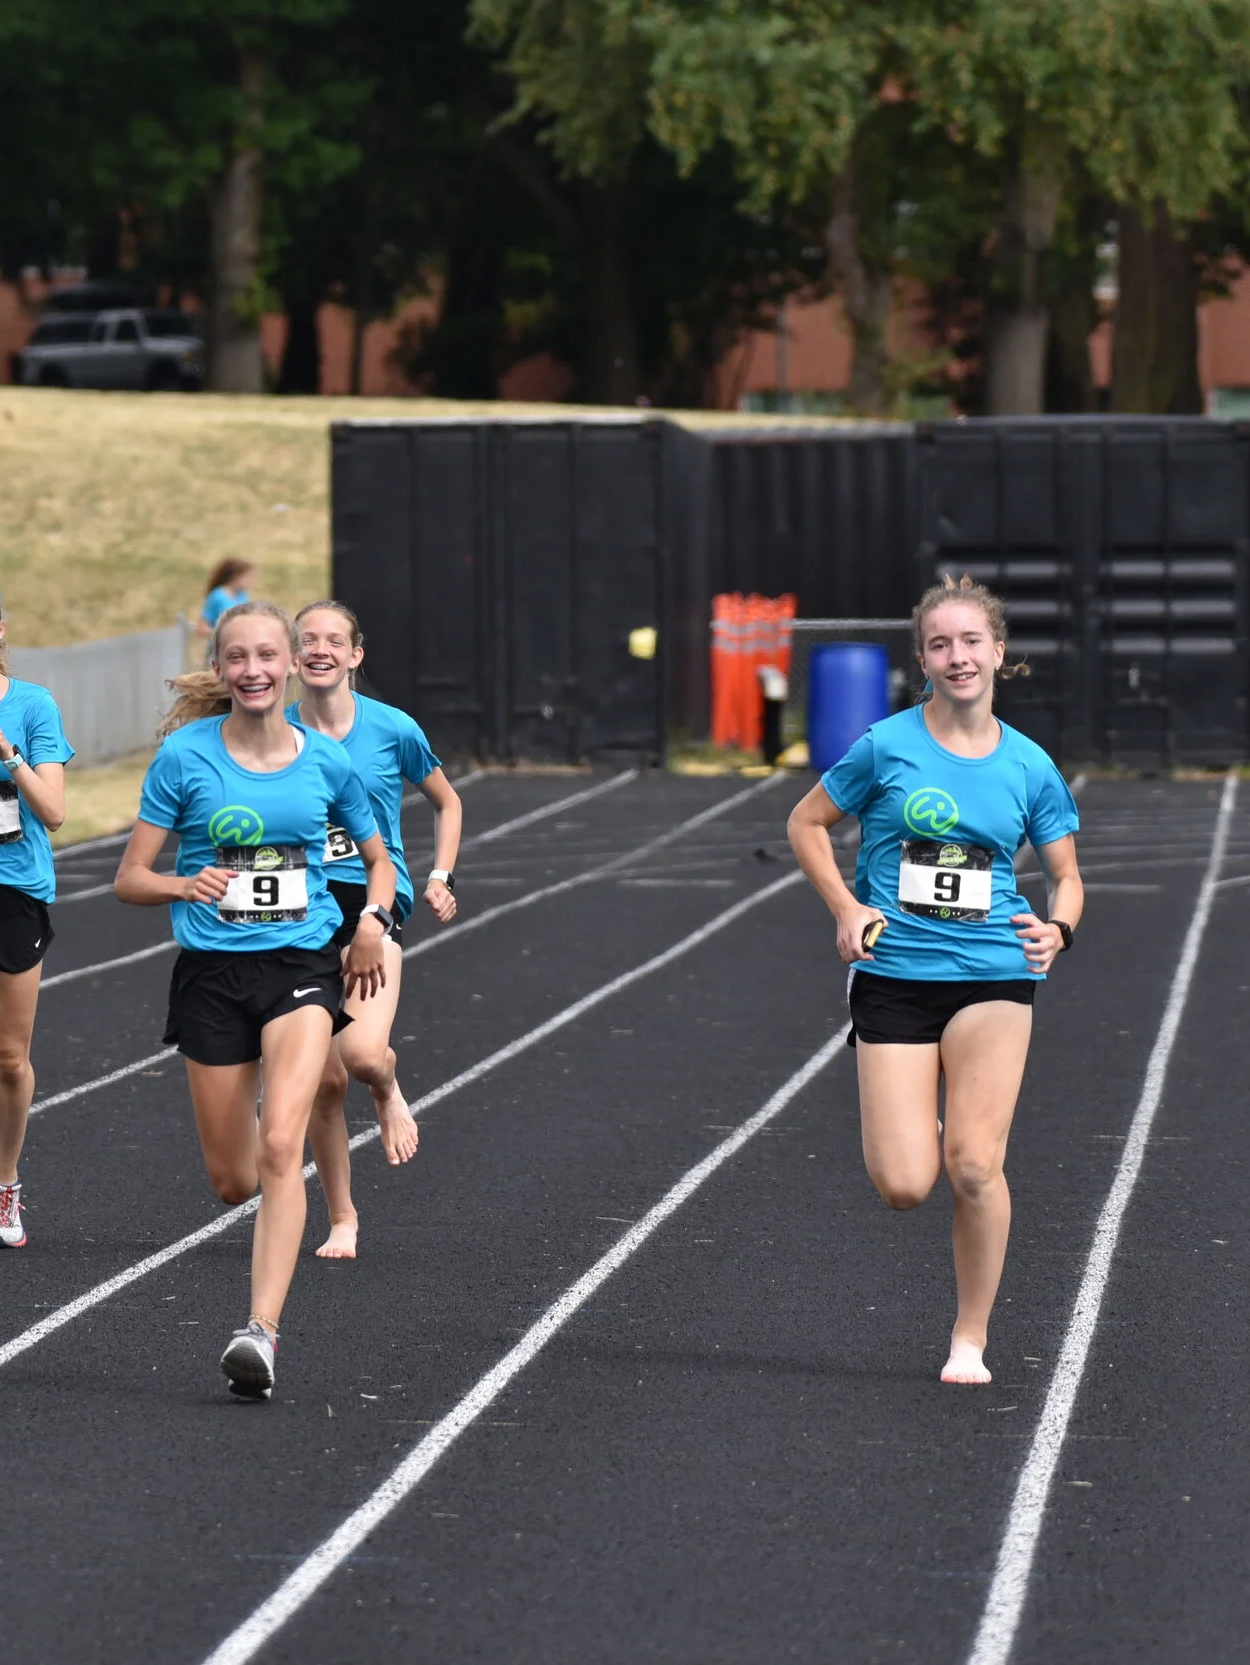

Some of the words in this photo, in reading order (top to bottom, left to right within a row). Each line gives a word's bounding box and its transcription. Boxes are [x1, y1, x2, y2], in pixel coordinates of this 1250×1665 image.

[328, 830, 353, 857] 9
[253, 875, 279, 906] 9
[934, 871, 961, 902] 9
